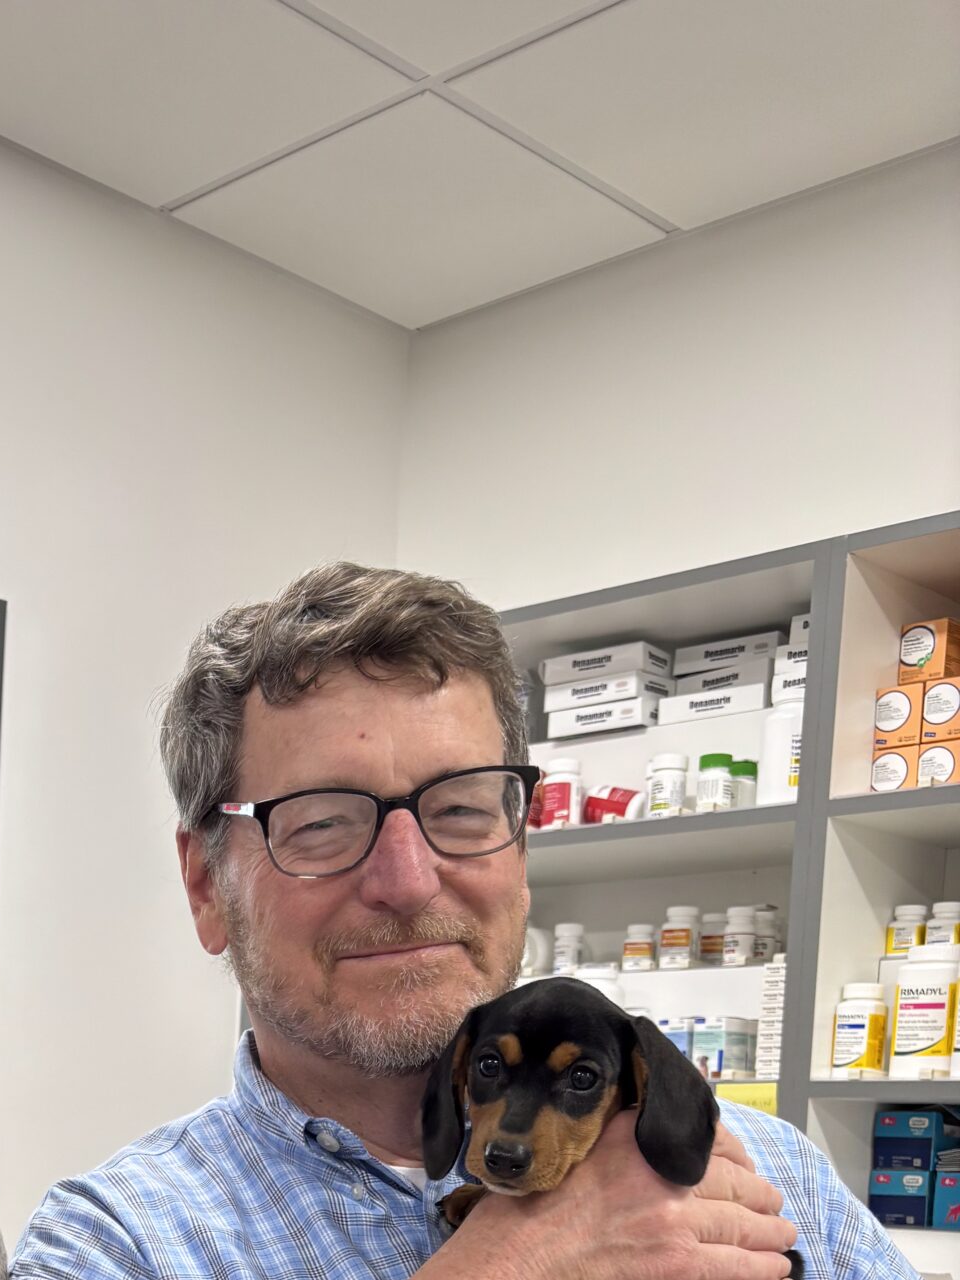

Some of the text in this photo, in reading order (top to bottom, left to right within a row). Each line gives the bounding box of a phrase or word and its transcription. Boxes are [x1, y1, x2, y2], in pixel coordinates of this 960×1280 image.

[704, 645, 745, 659] Denamarin
[572, 655, 612, 669] Denamarin
[702, 672, 739, 688] Denamarin
[783, 677, 806, 689] Denam
[571, 683, 607, 696] Denamarin
[689, 696, 731, 709] Denamarin
[575, 710, 612, 723] Denamarin
[901, 988, 944, 996] RIMADYL
